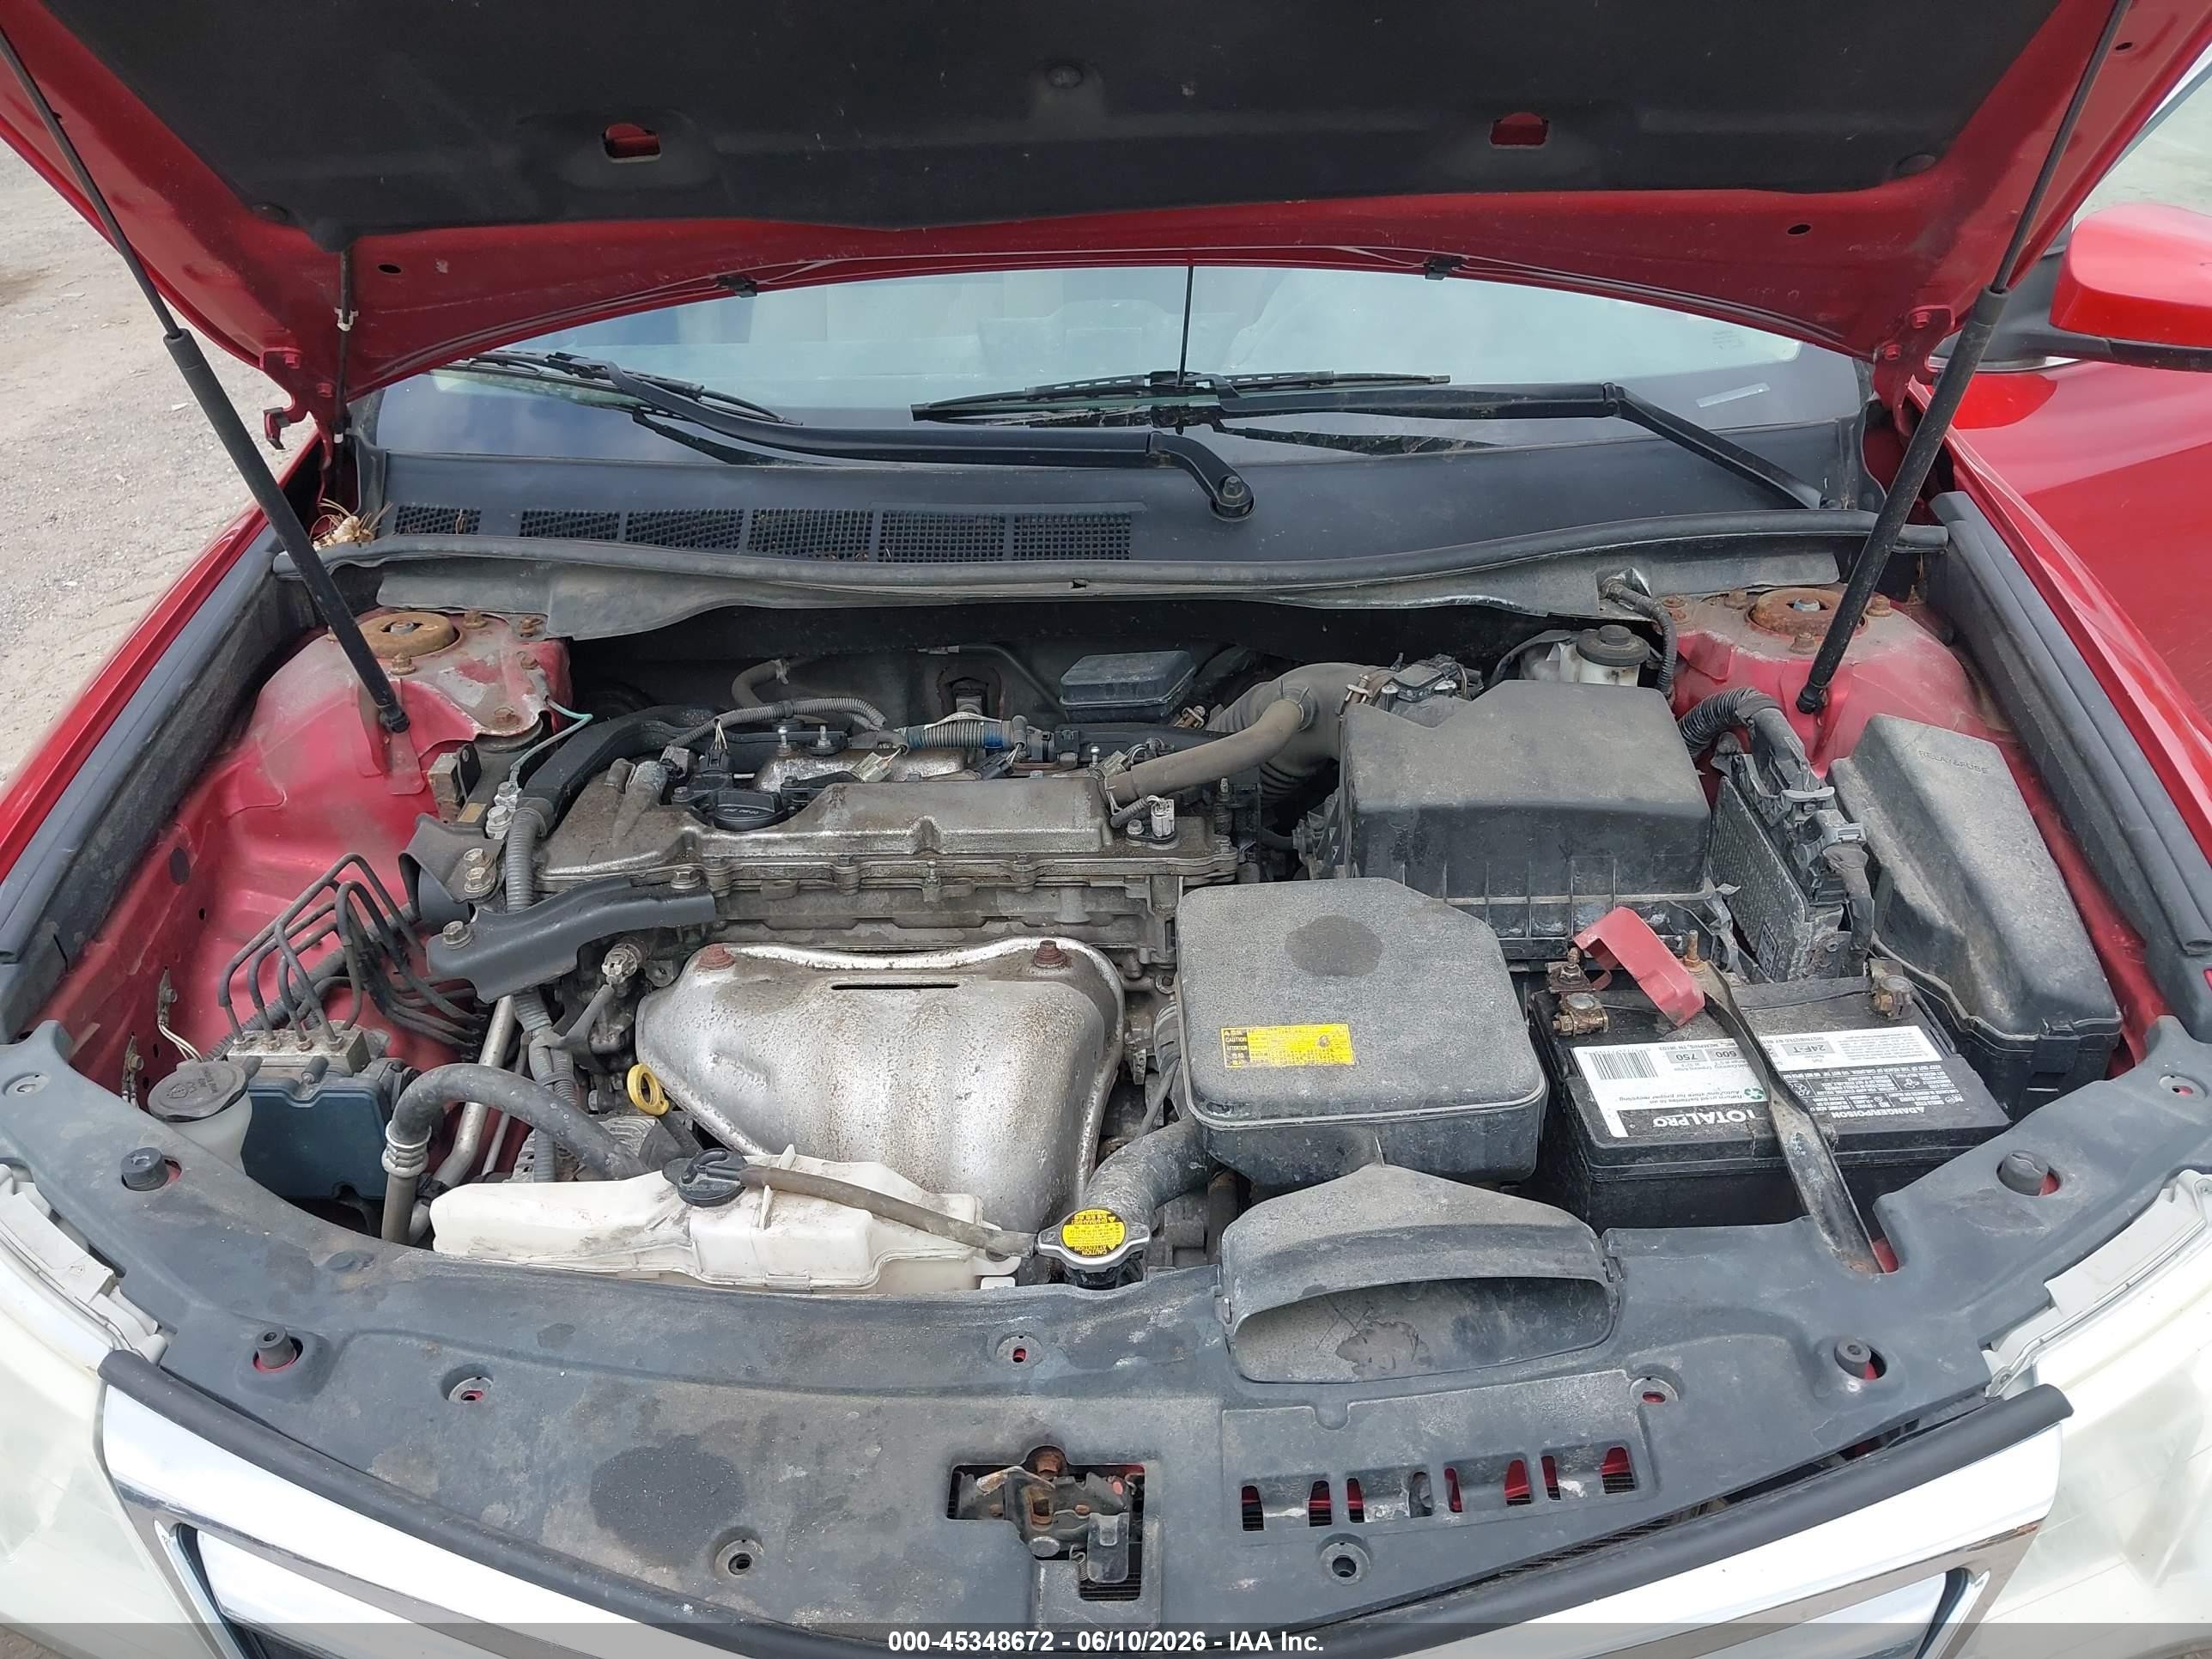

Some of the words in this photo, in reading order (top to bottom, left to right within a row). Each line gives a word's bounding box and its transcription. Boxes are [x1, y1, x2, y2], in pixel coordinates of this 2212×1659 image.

[1793, 1044, 1826, 1054] 24F-T
[1675, 1053, 1698, 1061] 750
[1830, 1106, 1917, 1119] DANGER/POISON
